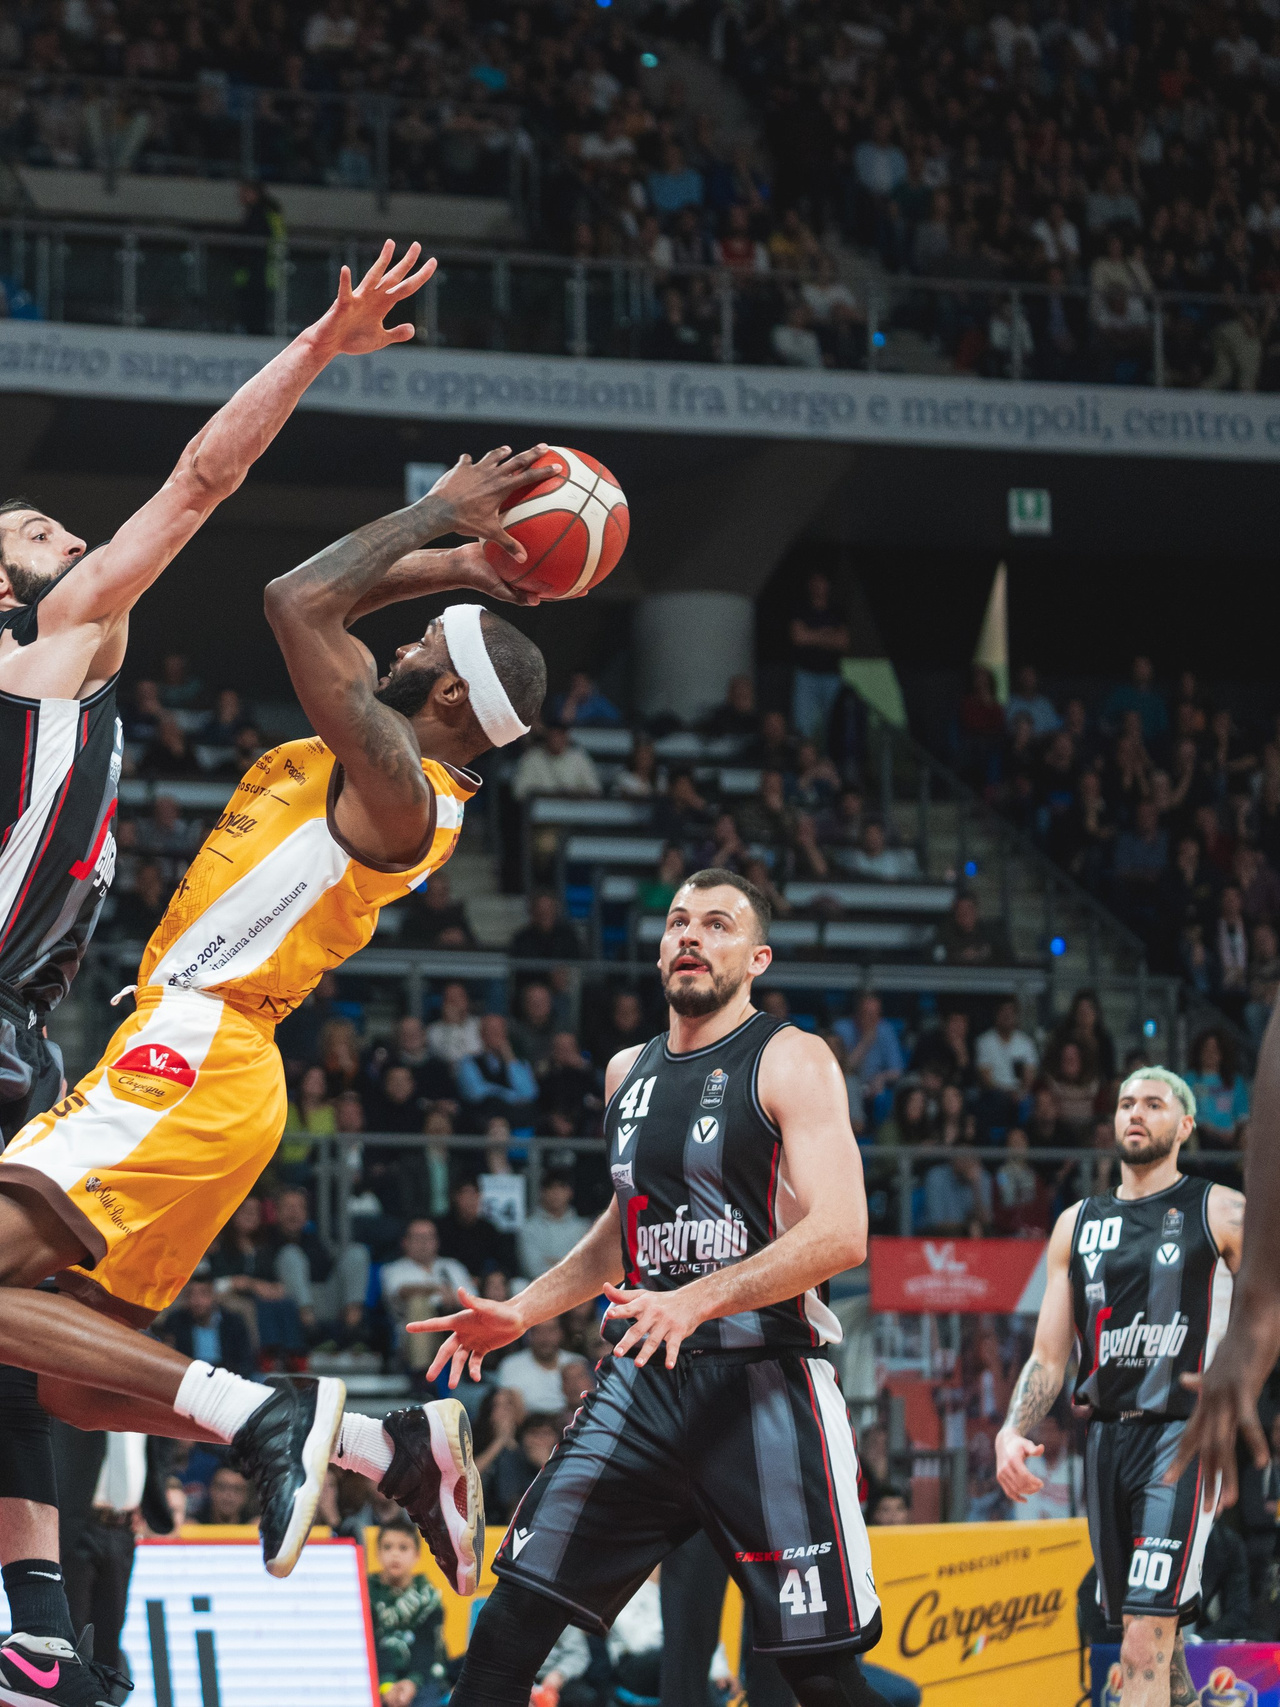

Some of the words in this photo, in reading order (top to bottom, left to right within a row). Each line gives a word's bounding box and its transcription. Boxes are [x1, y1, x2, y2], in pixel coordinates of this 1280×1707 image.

[405, 366, 658, 415] opposizioni
[669, 371, 728, 416] fra
[733, 374, 858, 428] borgo
[1122, 405, 1255, 442] centro
[209, 935, 250, 972] italiana
[248, 915, 274, 939] della
[271, 880, 308, 917] cultura
[197, 934, 227, 965] 2024
[618, 1075, 658, 1120] 41
[706, 1083, 723, 1092] LBA
[1078, 1216, 1123, 1255] 00
[937, 1546, 1032, 1579] PROSCIUTTO
[1128, 1549, 1173, 1592] 00
[779, 1565, 828, 1616] 41
[898, 1586, 1068, 1662] Carpegna
